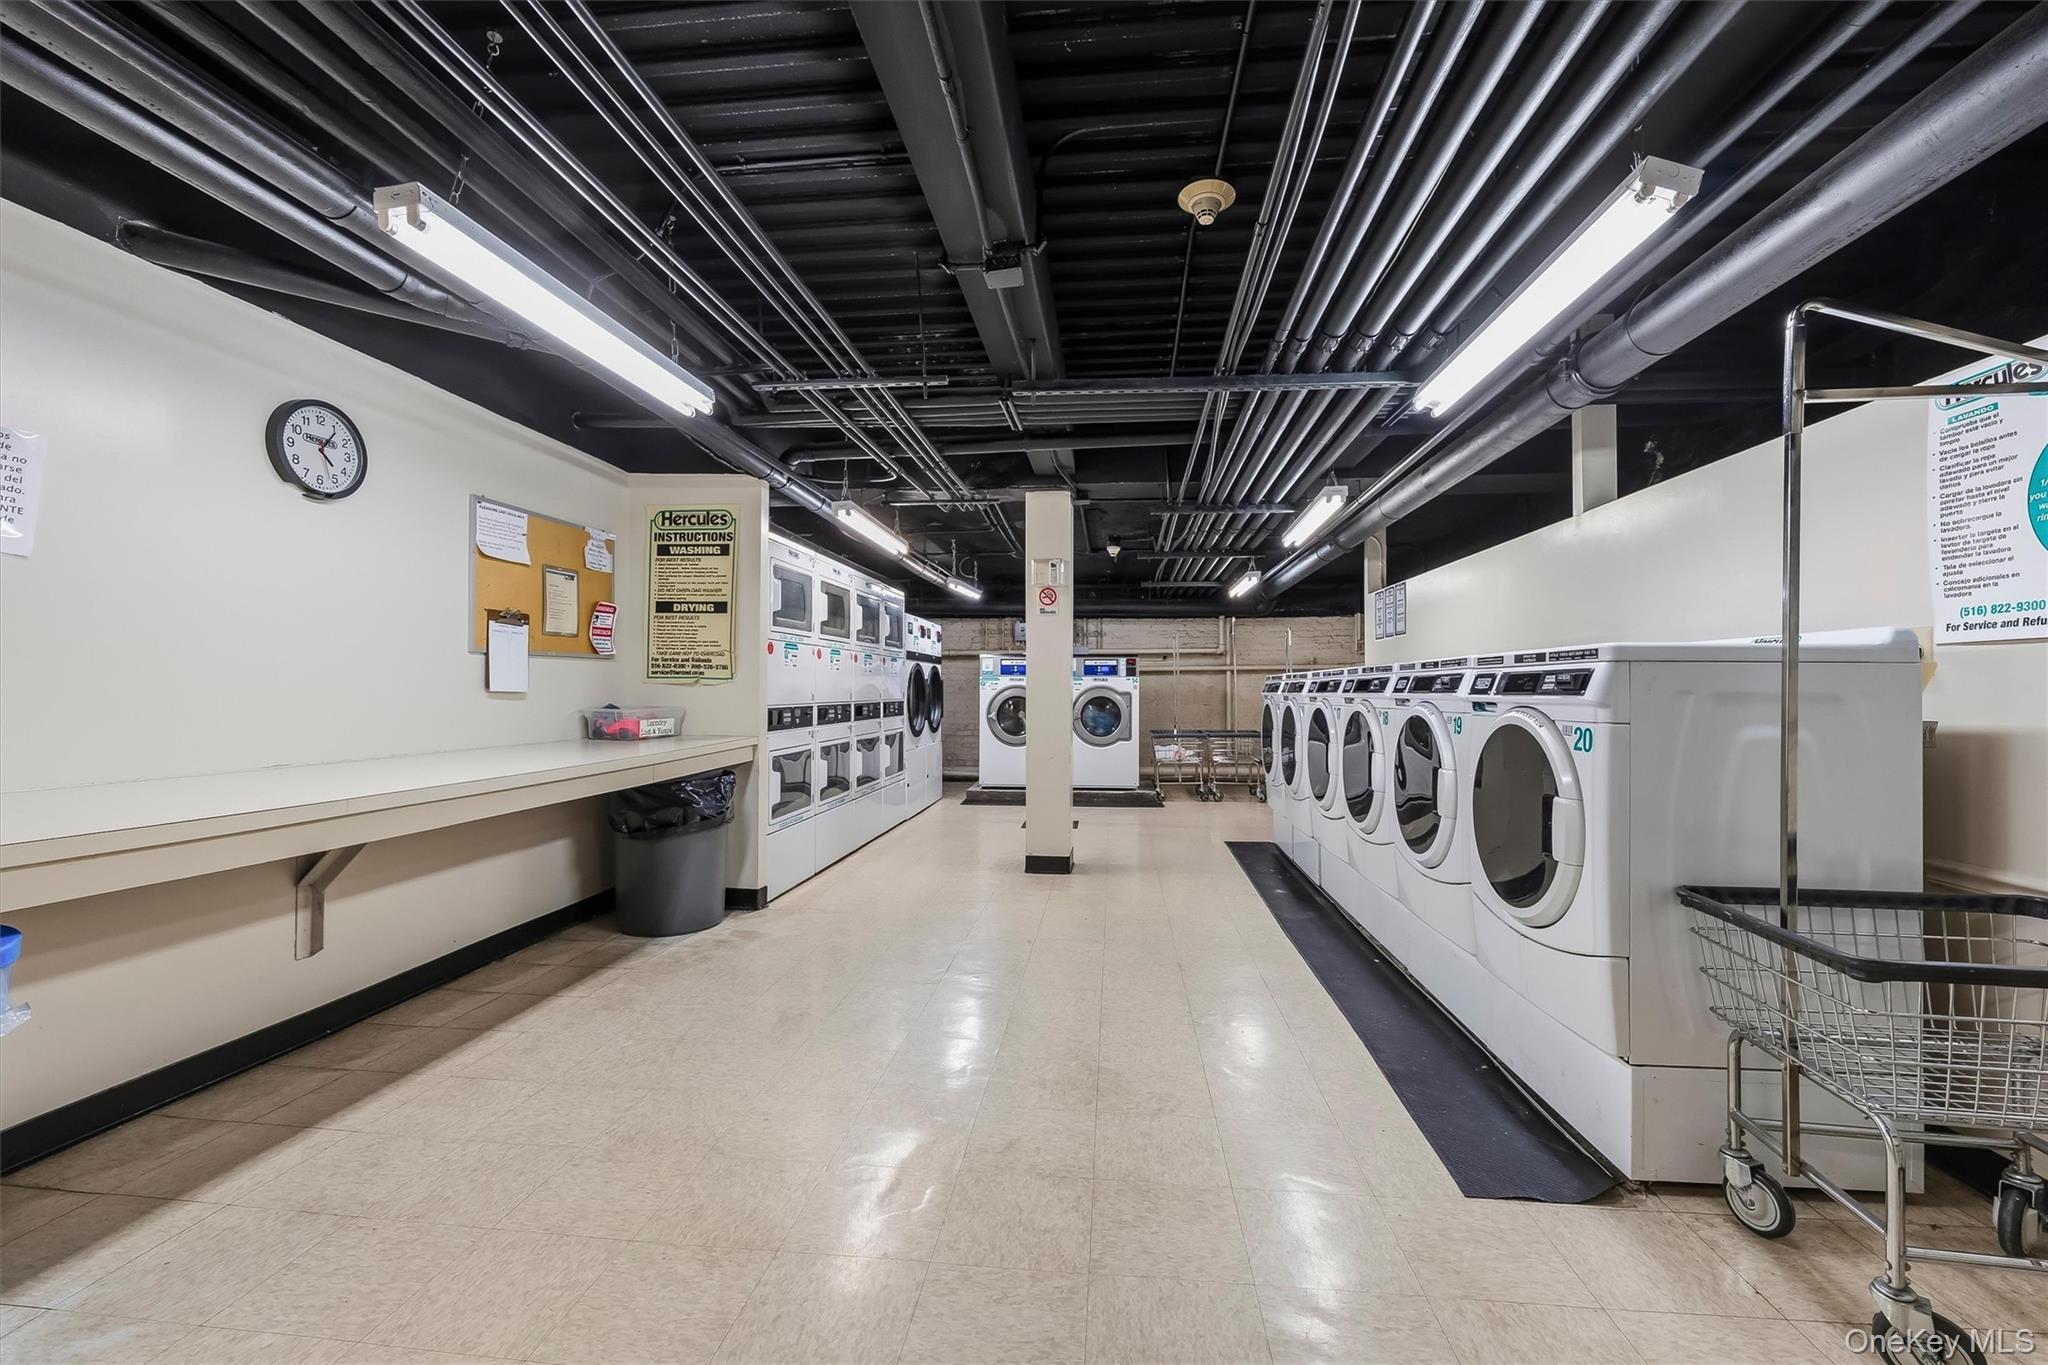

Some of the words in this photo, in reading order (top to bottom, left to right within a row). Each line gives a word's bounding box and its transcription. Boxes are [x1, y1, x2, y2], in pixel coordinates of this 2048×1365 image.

[1951, 404, 1994, 423] LAVANDO
[302, 416, 310, 426] 11
[316, 415, 326, 426] 12
[291, 424, 302, 435] 10
[286, 436, 294, 448] 9
[342, 438, 348, 448] 2
[12, 456, 27, 464] no
[292, 454, 300, 464] 8
[344, 452, 351, 462] 3
[303, 467, 310, 478] 7
[341, 467, 347, 476] 4
[4, 474, 22, 484] del
[317, 475, 324, 485] 6
[332, 474, 338, 484] 5
[2030, 492, 2046, 503] you
[661, 511, 728, 526] Hercules
[654, 532, 734, 542] INSTRUCTIONS
[669, 546, 721, 554] WASHING
[673, 604, 715, 612] DRYING
[1960, 605, 1987, 619] (516)
[1991, 600, 2046, 614] 822-9300
[1946, 623, 1961, 632] For
[1963, 620, 1997, 631] Service
[2000, 618, 2019, 628] and
[1453, 716, 1462, 734] 19
[1574, 727, 1593, 752] 20
